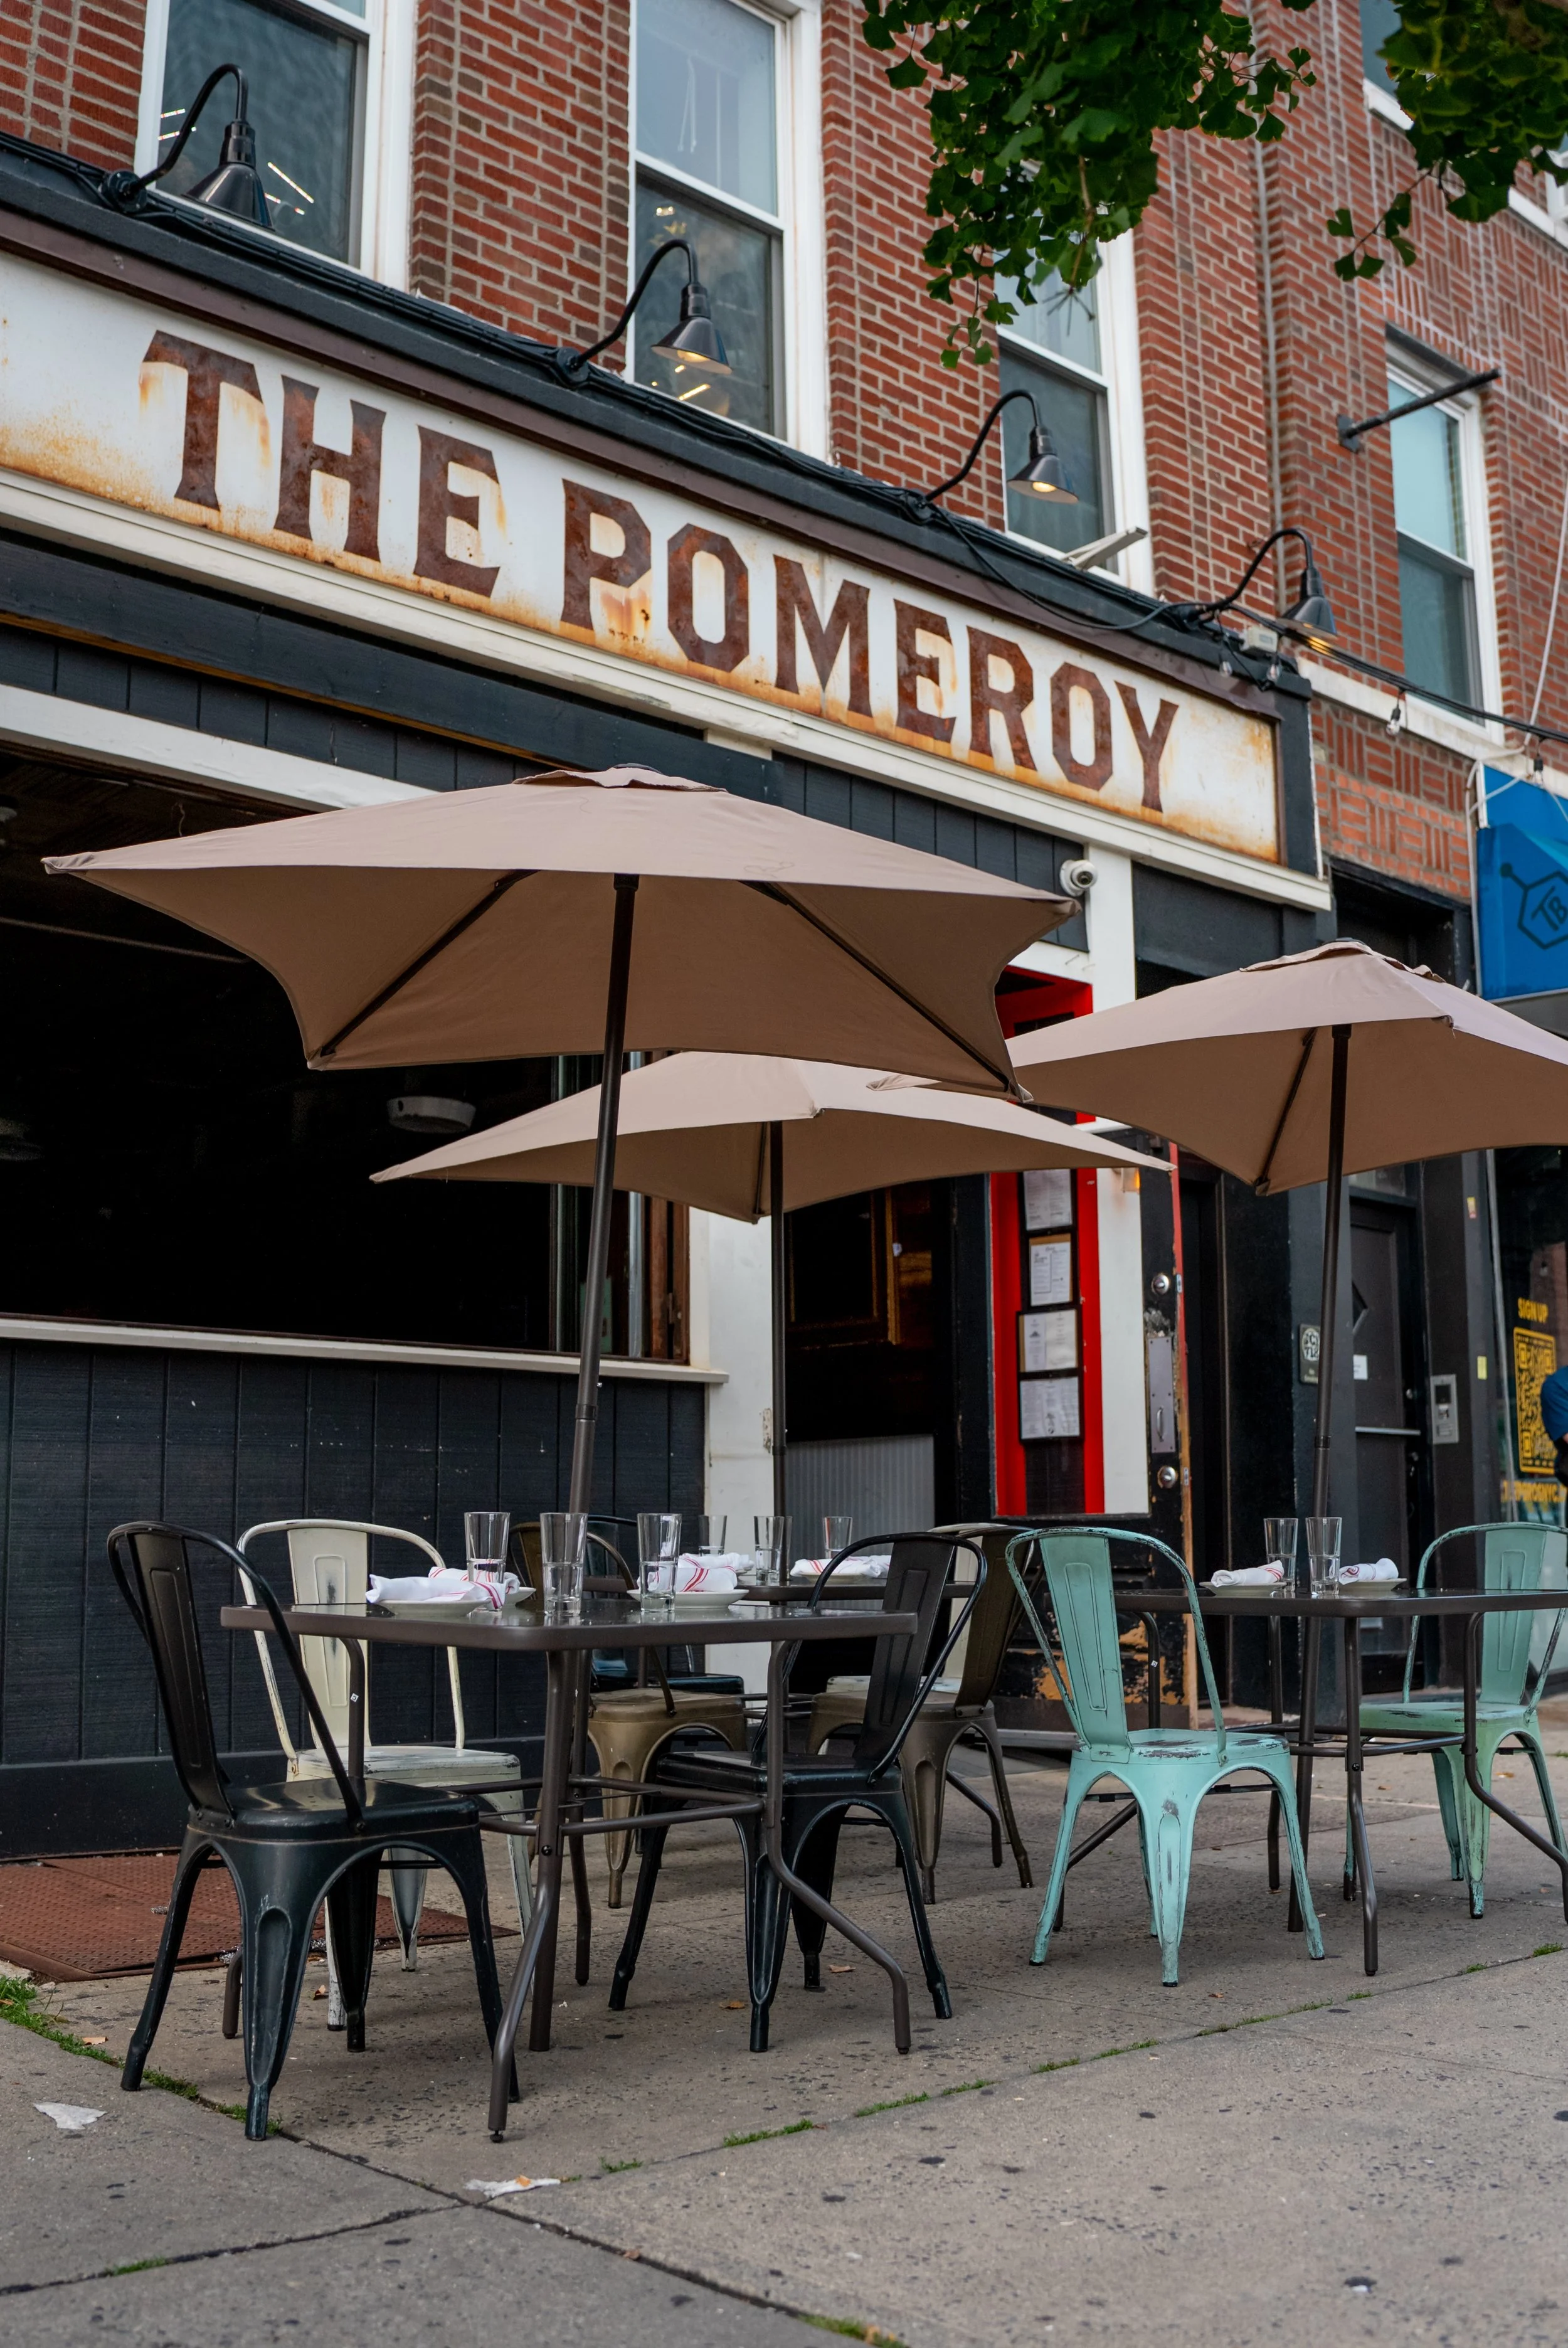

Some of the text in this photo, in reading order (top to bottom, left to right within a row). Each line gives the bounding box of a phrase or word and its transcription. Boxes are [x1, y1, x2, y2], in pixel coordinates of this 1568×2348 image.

[141, 330, 1179, 814] THE POMEROY
[1530, 885, 1568, 932] TB
[1517, 1297, 1549, 1324] SIGN UP
